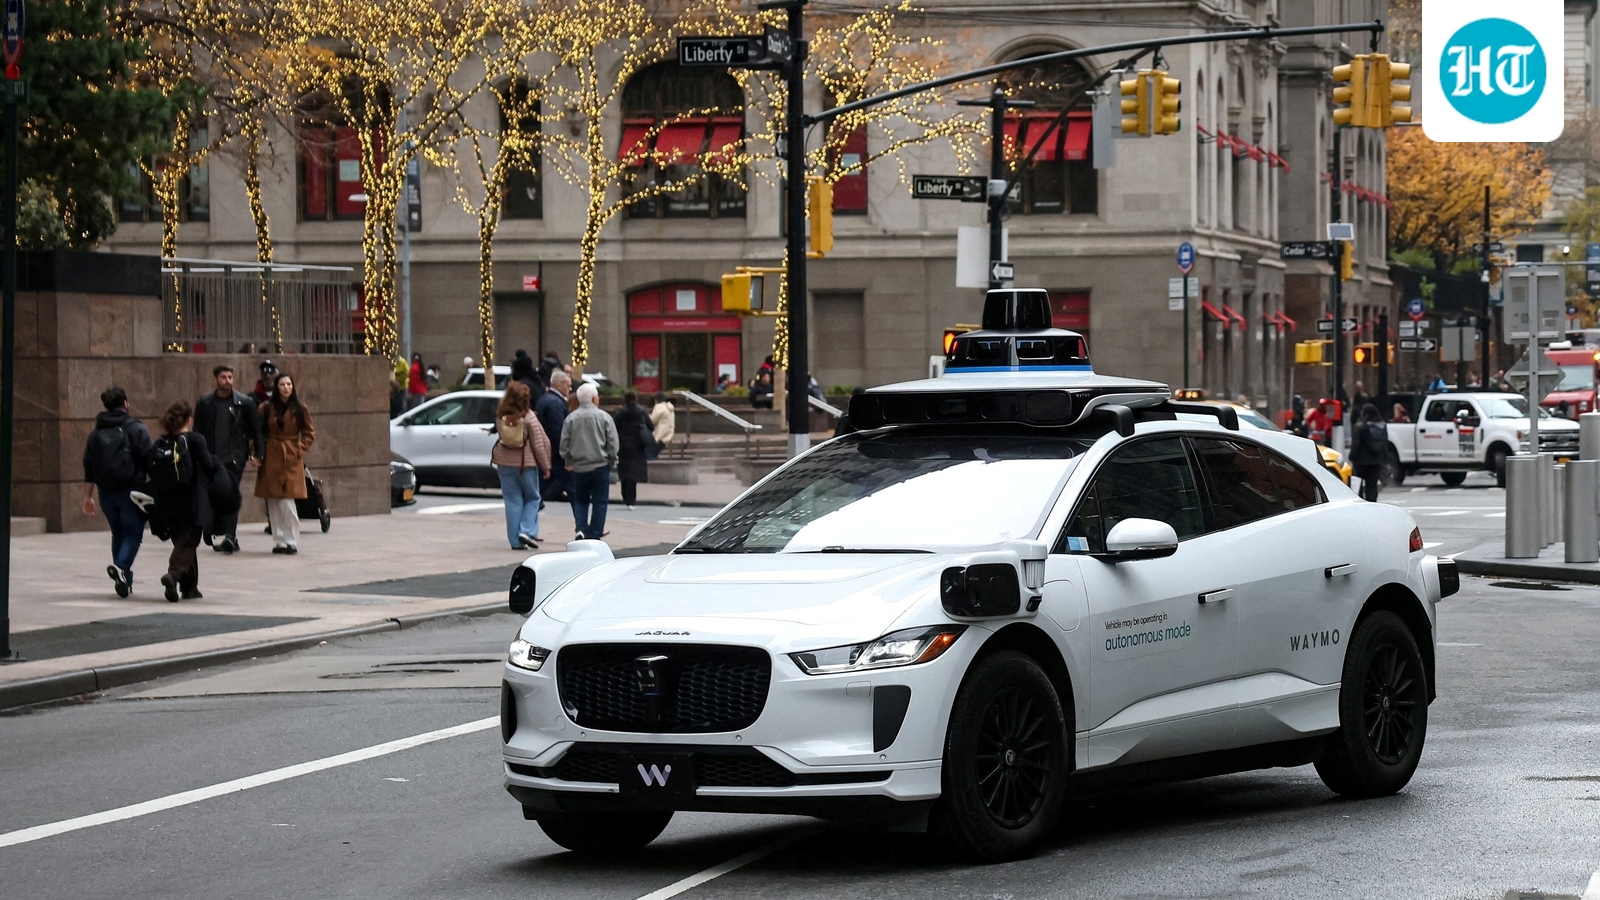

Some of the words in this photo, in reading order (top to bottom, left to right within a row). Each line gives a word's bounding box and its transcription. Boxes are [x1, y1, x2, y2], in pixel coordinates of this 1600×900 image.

[685, 46, 733, 64] Liberty
[917, 181, 953, 196] Liberty
[1104, 620, 1122, 630] Vehicle
[1122, 619, 1133, 629] may
[1133, 616, 1140, 626] be
[1140, 613, 1163, 626] operating
[1163, 612, 1168, 621] in
[1105, 629, 1163, 651] autonomous
[1165, 620, 1191, 640] mode
[1290, 628, 1340, 651] WAYMO
